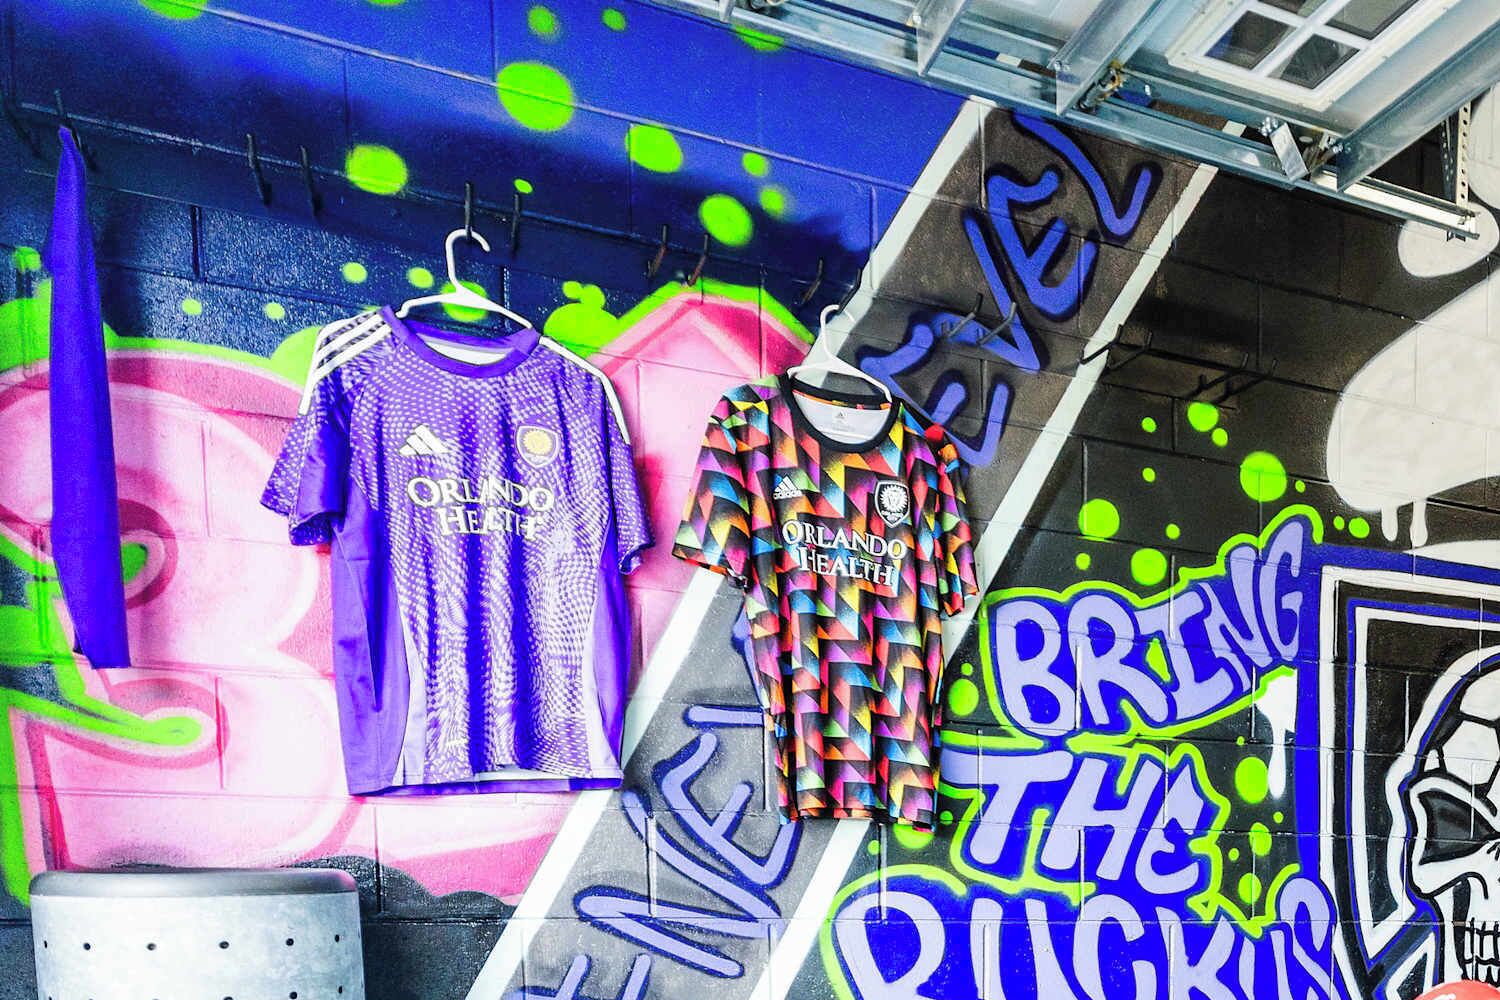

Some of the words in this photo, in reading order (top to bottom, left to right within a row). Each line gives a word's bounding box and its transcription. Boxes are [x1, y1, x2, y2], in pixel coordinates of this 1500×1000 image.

[859, 109, 1156, 467] EVEL
[406, 475, 555, 512] ORLANDO
[782, 520, 907, 559] ORLANDO
[798, 545, 894, 586] HEALTH
[993, 520, 1302, 736] BRING
[941, 748, 1214, 895] THE
